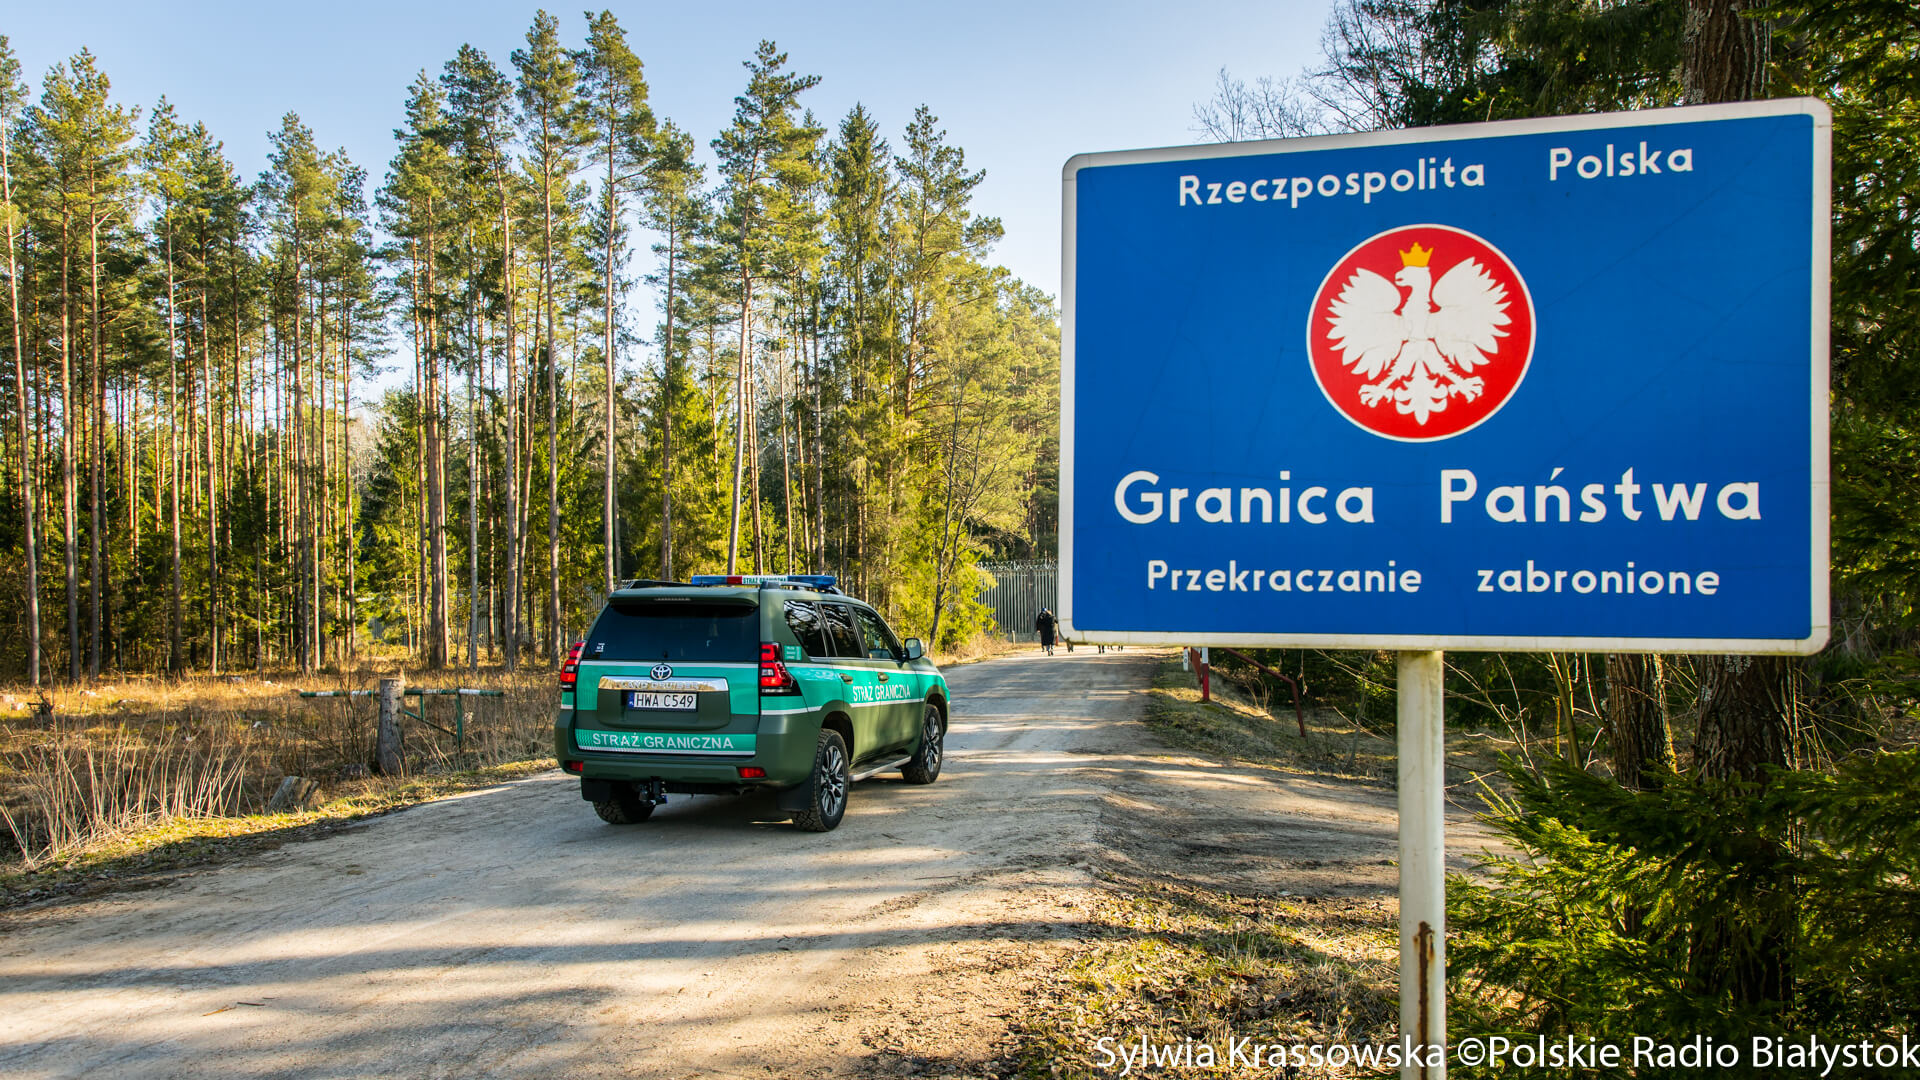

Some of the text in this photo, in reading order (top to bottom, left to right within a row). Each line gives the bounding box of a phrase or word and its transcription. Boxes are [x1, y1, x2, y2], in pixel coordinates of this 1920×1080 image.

[1179, 141, 1694, 209] Rzeczpospolita Polska
[1114, 467, 1762, 524] Granica Państwa
[1148, 559, 1720, 595] Przekraczanie zabronione
[636, 694, 694, 708] HWA C549
[853, 682, 911, 702] STRAŻ GRANICZNA
[592, 732, 734, 749] STRAŻ GRANICZNA
